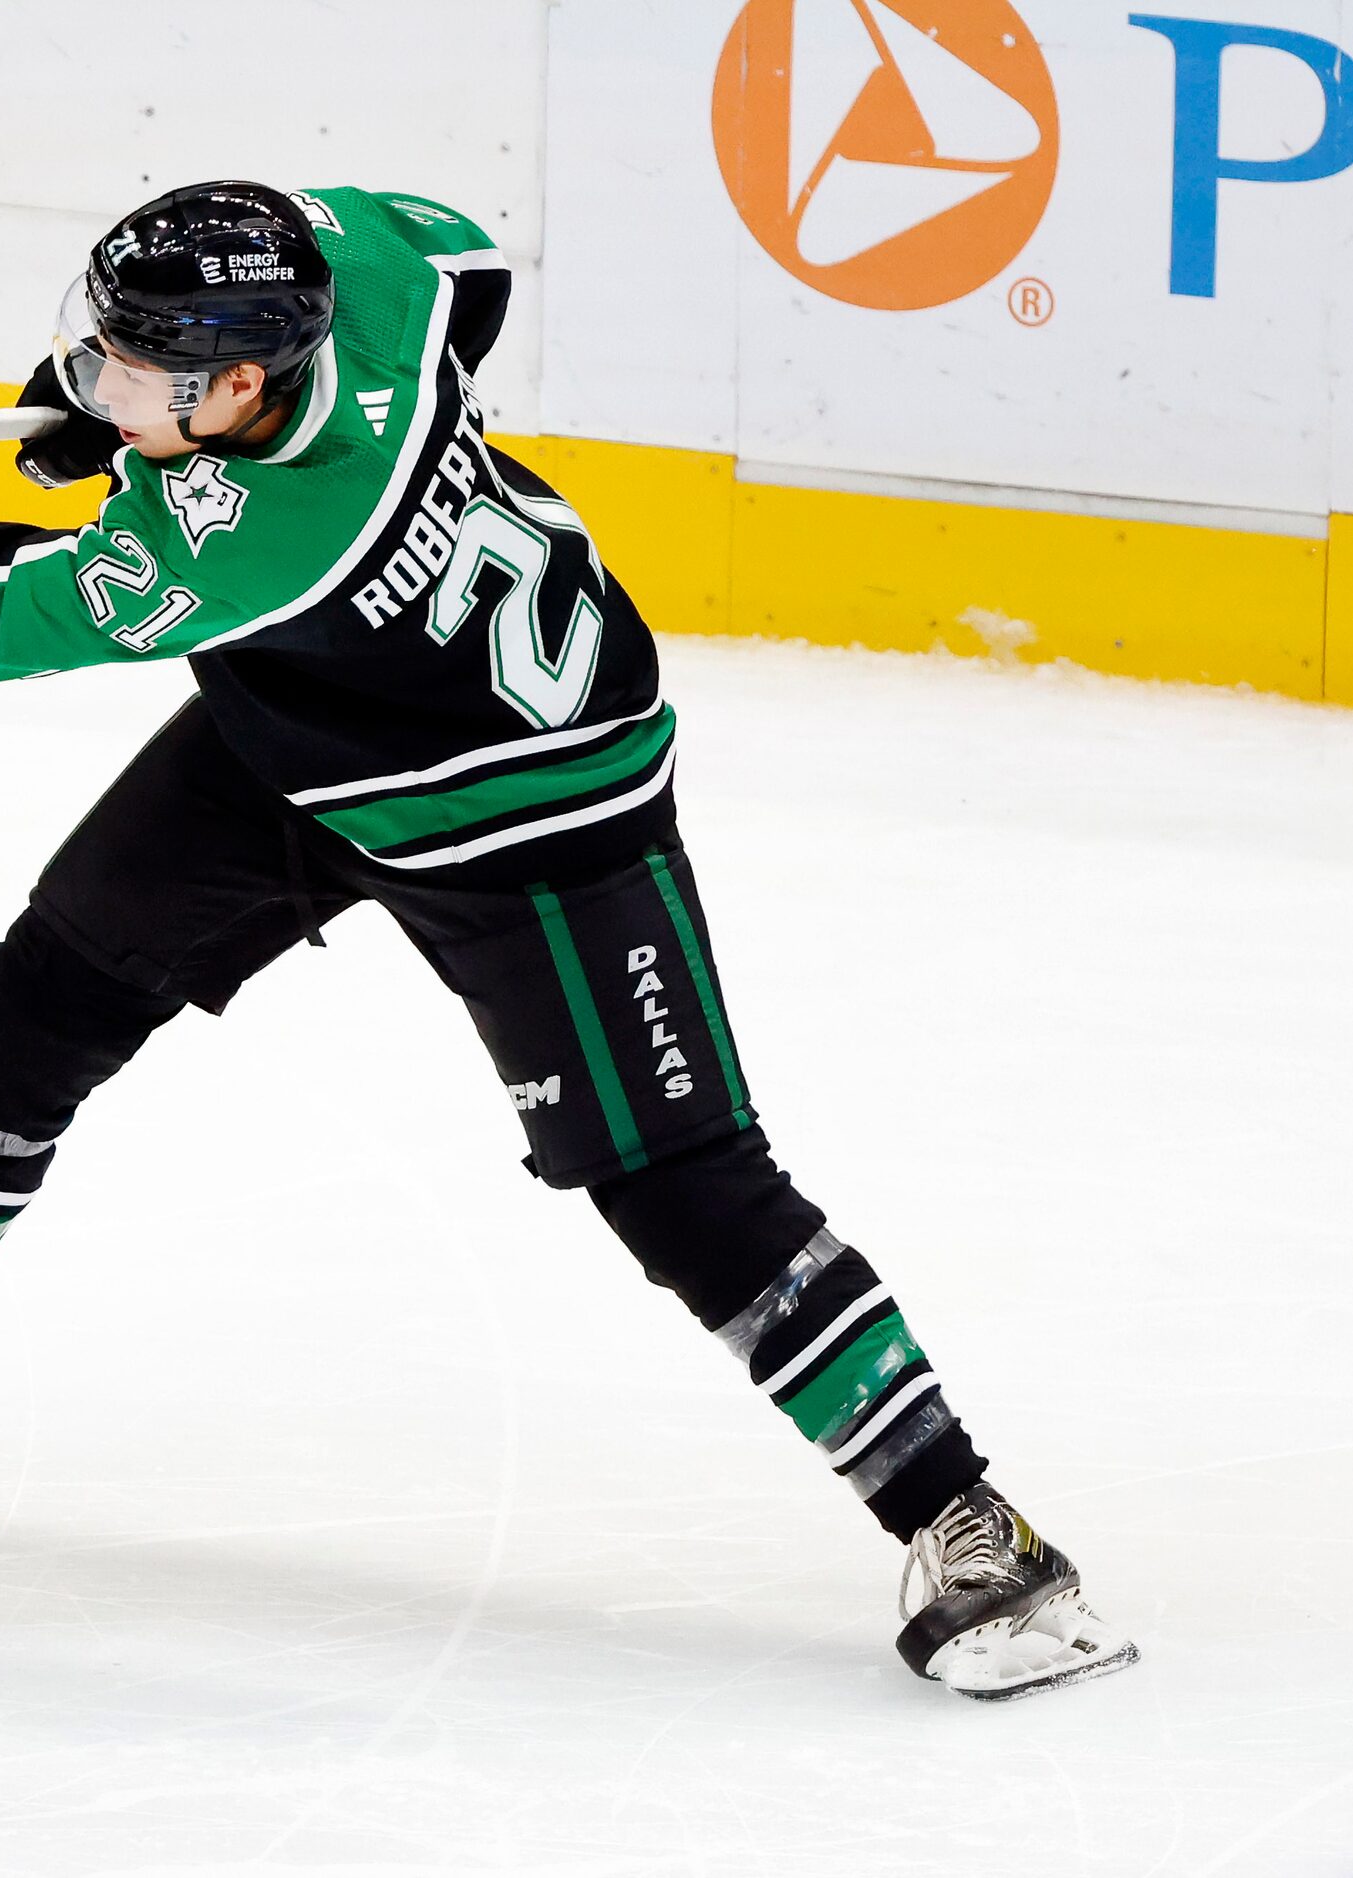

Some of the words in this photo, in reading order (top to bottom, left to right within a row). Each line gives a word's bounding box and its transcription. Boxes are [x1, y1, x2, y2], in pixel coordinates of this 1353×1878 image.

[228, 253, 280, 268] ENERGY
[229, 267, 295, 282] TRANSFER
[76, 530, 204, 653] 21
[628, 945, 693, 1099] DALLAS
[507, 1075, 561, 1110] CM
